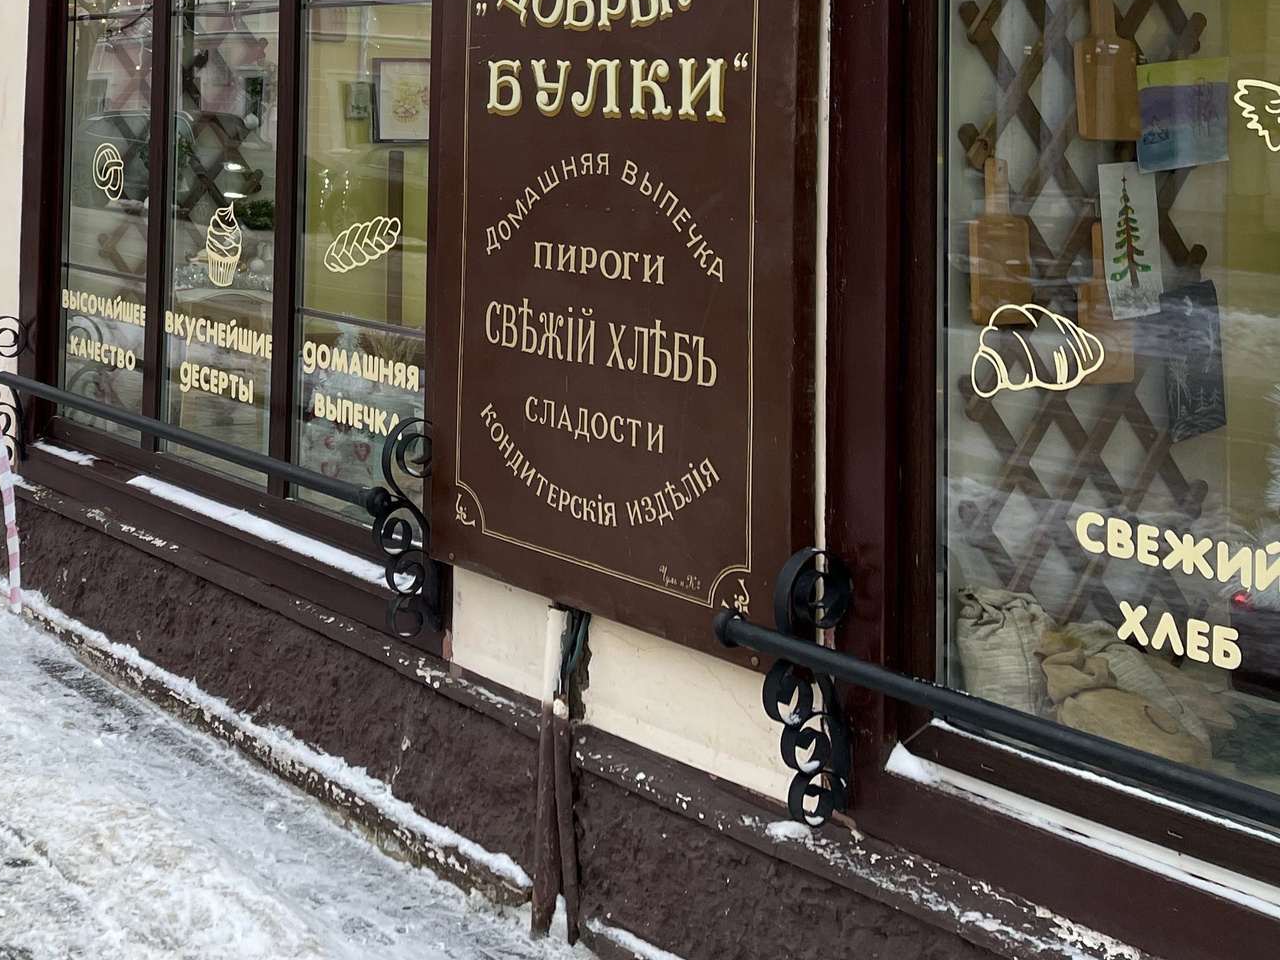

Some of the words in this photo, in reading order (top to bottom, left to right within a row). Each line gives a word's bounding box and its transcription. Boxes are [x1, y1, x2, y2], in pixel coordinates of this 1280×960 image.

[485, 152, 610, 255] ДОМАШНЯЯ
[621, 159, 725, 283] ВЫПЕЧКА
[533, 240, 666, 286] ПИРОГИ
[61, 288, 146, 327] ВЫСОЧАЙШЕЕ
[70, 335, 136, 371] КАЧЕСТВО
[164, 310, 273, 359] ВКУСНЕЙШИЕ
[524, 395, 665, 454] СЛАДОСТИ
[1117, 601, 1242, 670] ХЛЕБ
